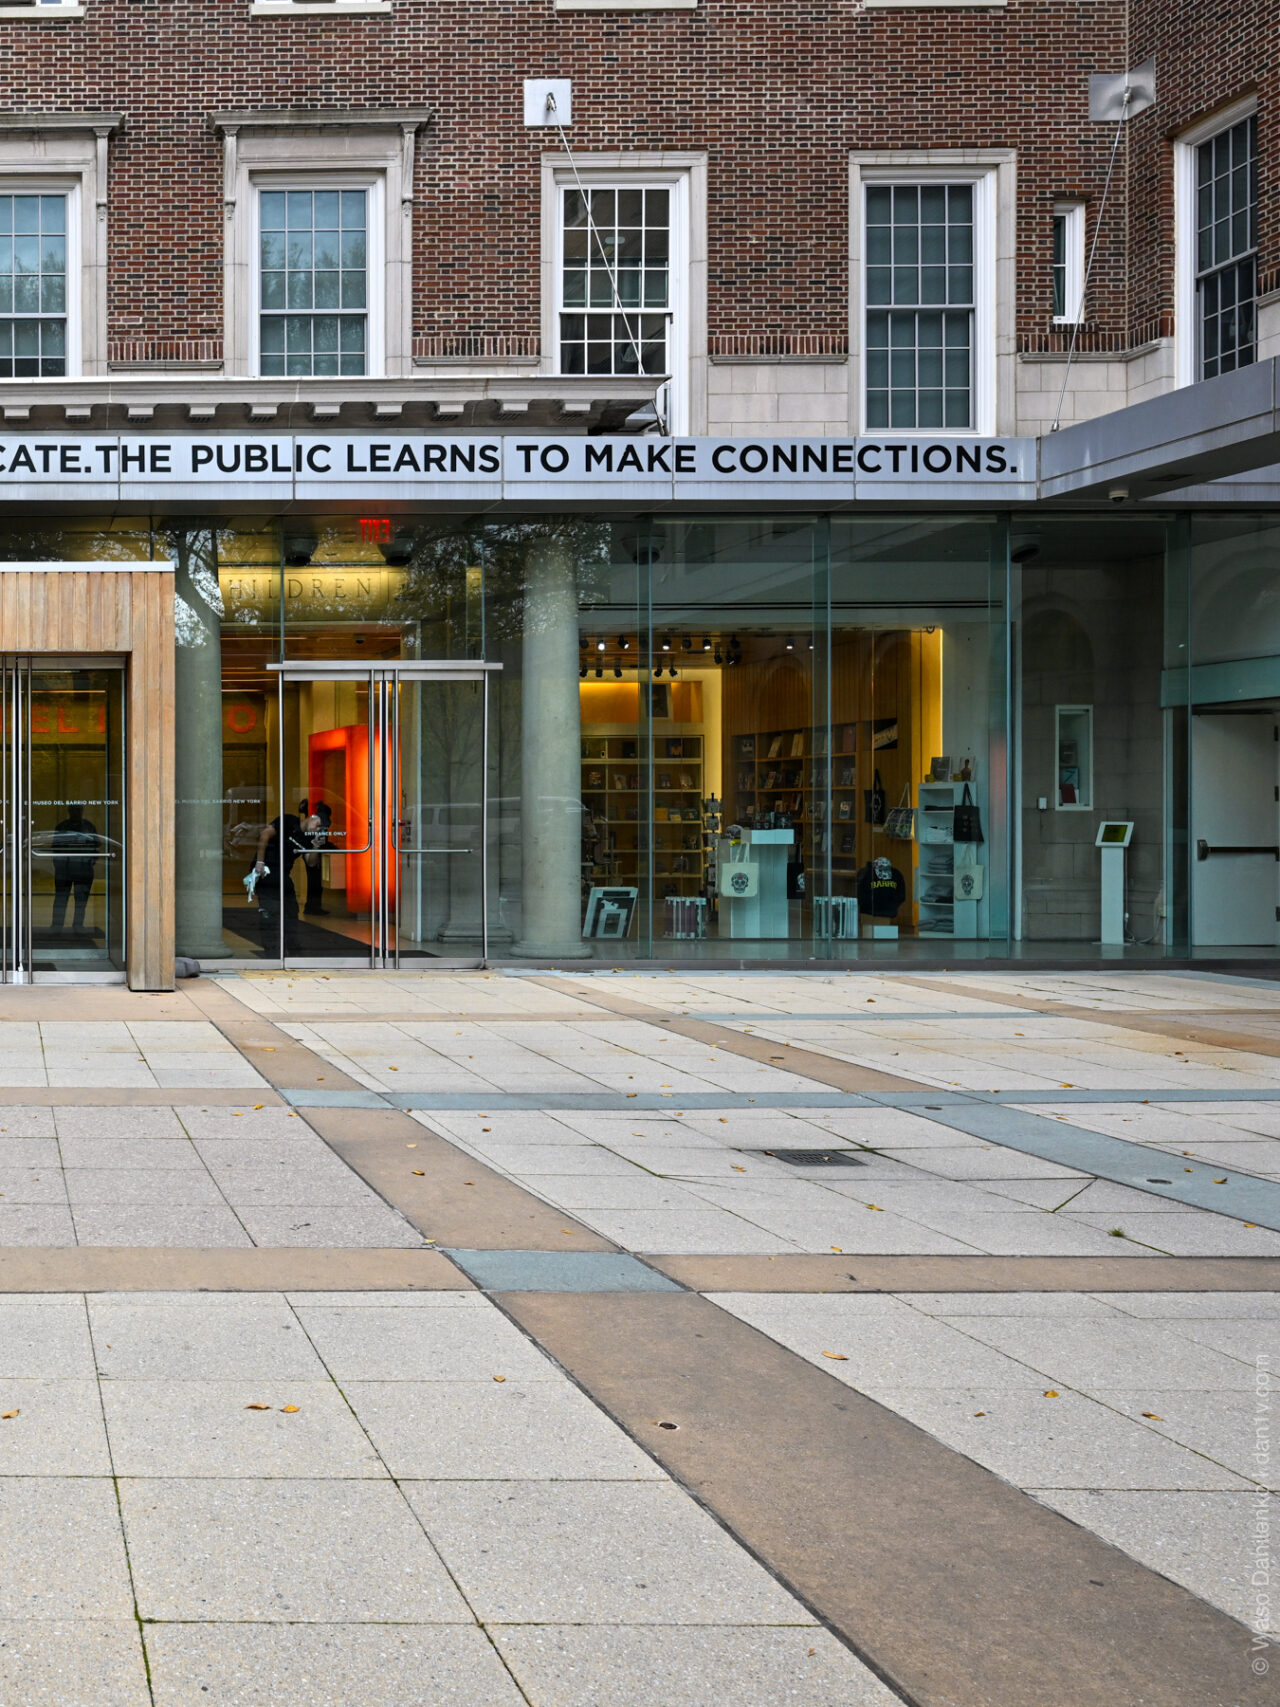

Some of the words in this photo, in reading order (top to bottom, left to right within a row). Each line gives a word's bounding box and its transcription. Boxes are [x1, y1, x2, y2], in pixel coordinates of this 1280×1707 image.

[191, 444, 332, 473] PUBLIC
[347, 444, 500, 473] LEARNS
[516, 444, 570, 473] TO
[586, 444, 697, 473] MAKE
[711, 444, 1018, 474] CONNECTIONS.
[228, 577, 372, 600] HILDREN
